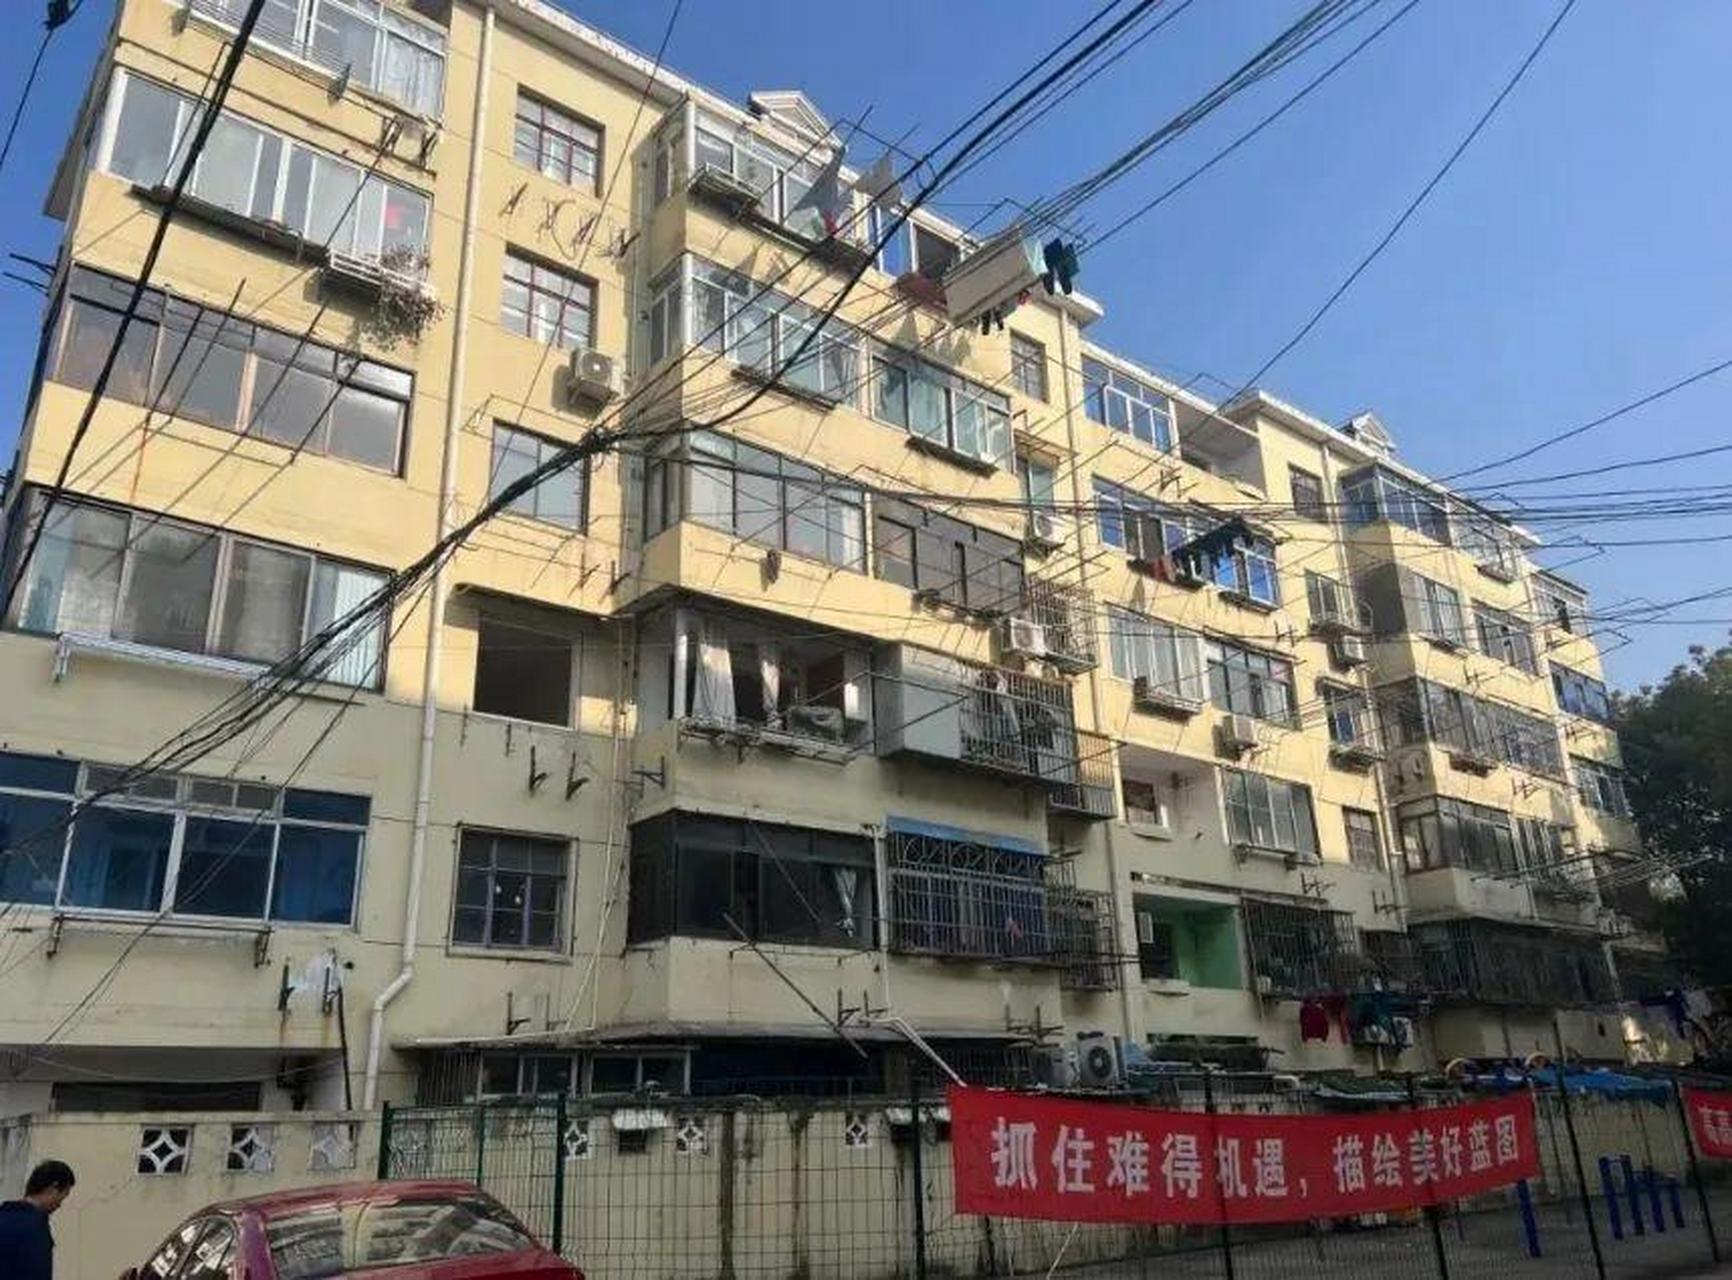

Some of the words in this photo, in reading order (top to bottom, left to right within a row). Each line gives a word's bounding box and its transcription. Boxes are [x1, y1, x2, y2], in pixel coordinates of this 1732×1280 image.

[990, 1114, 1520, 1198] 抓住难得机遇，描绘美好蓝图
